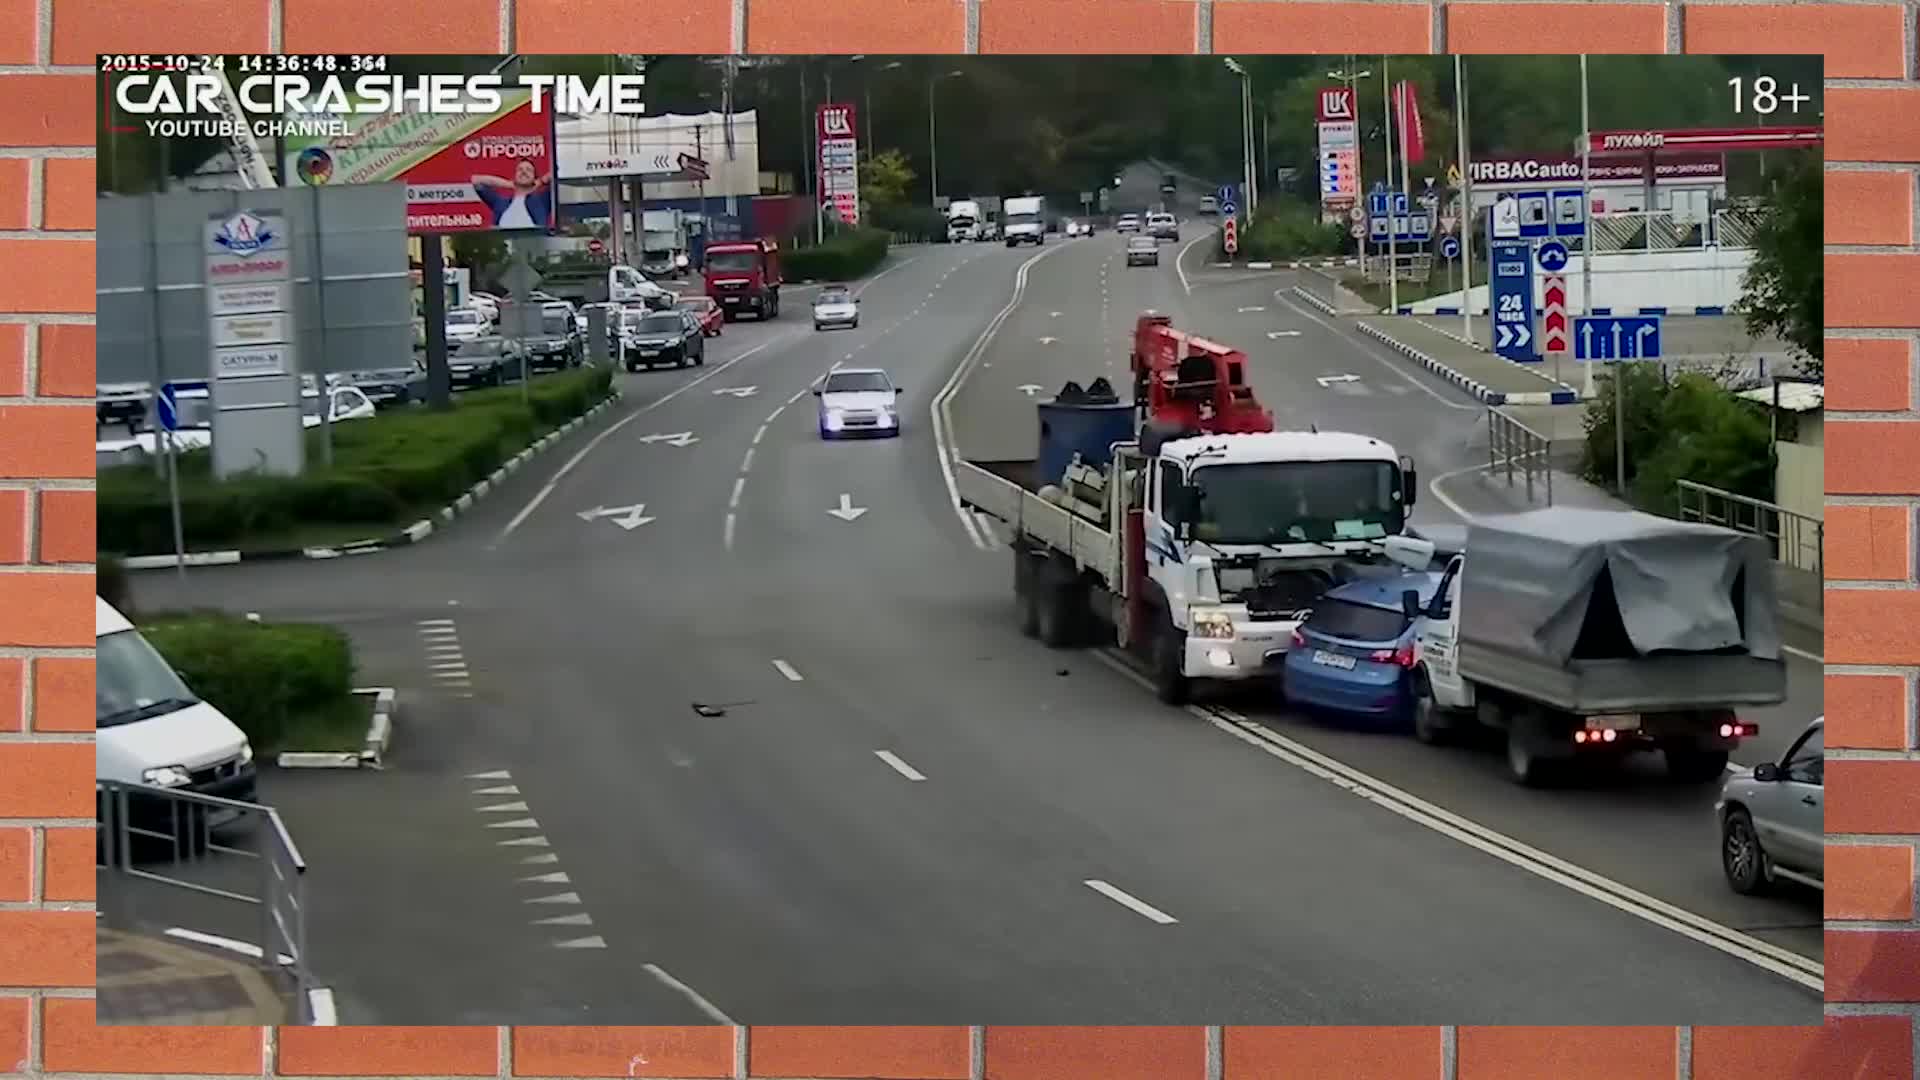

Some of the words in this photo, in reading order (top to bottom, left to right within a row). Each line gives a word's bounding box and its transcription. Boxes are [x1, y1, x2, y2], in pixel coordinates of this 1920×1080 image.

[1603, 132, 1665, 149] ЛУКОЙЛ
[482, 143, 546, 159] ПРОФИ
[419, 189, 465, 200] метров
[1500, 294, 1523, 311] 24
